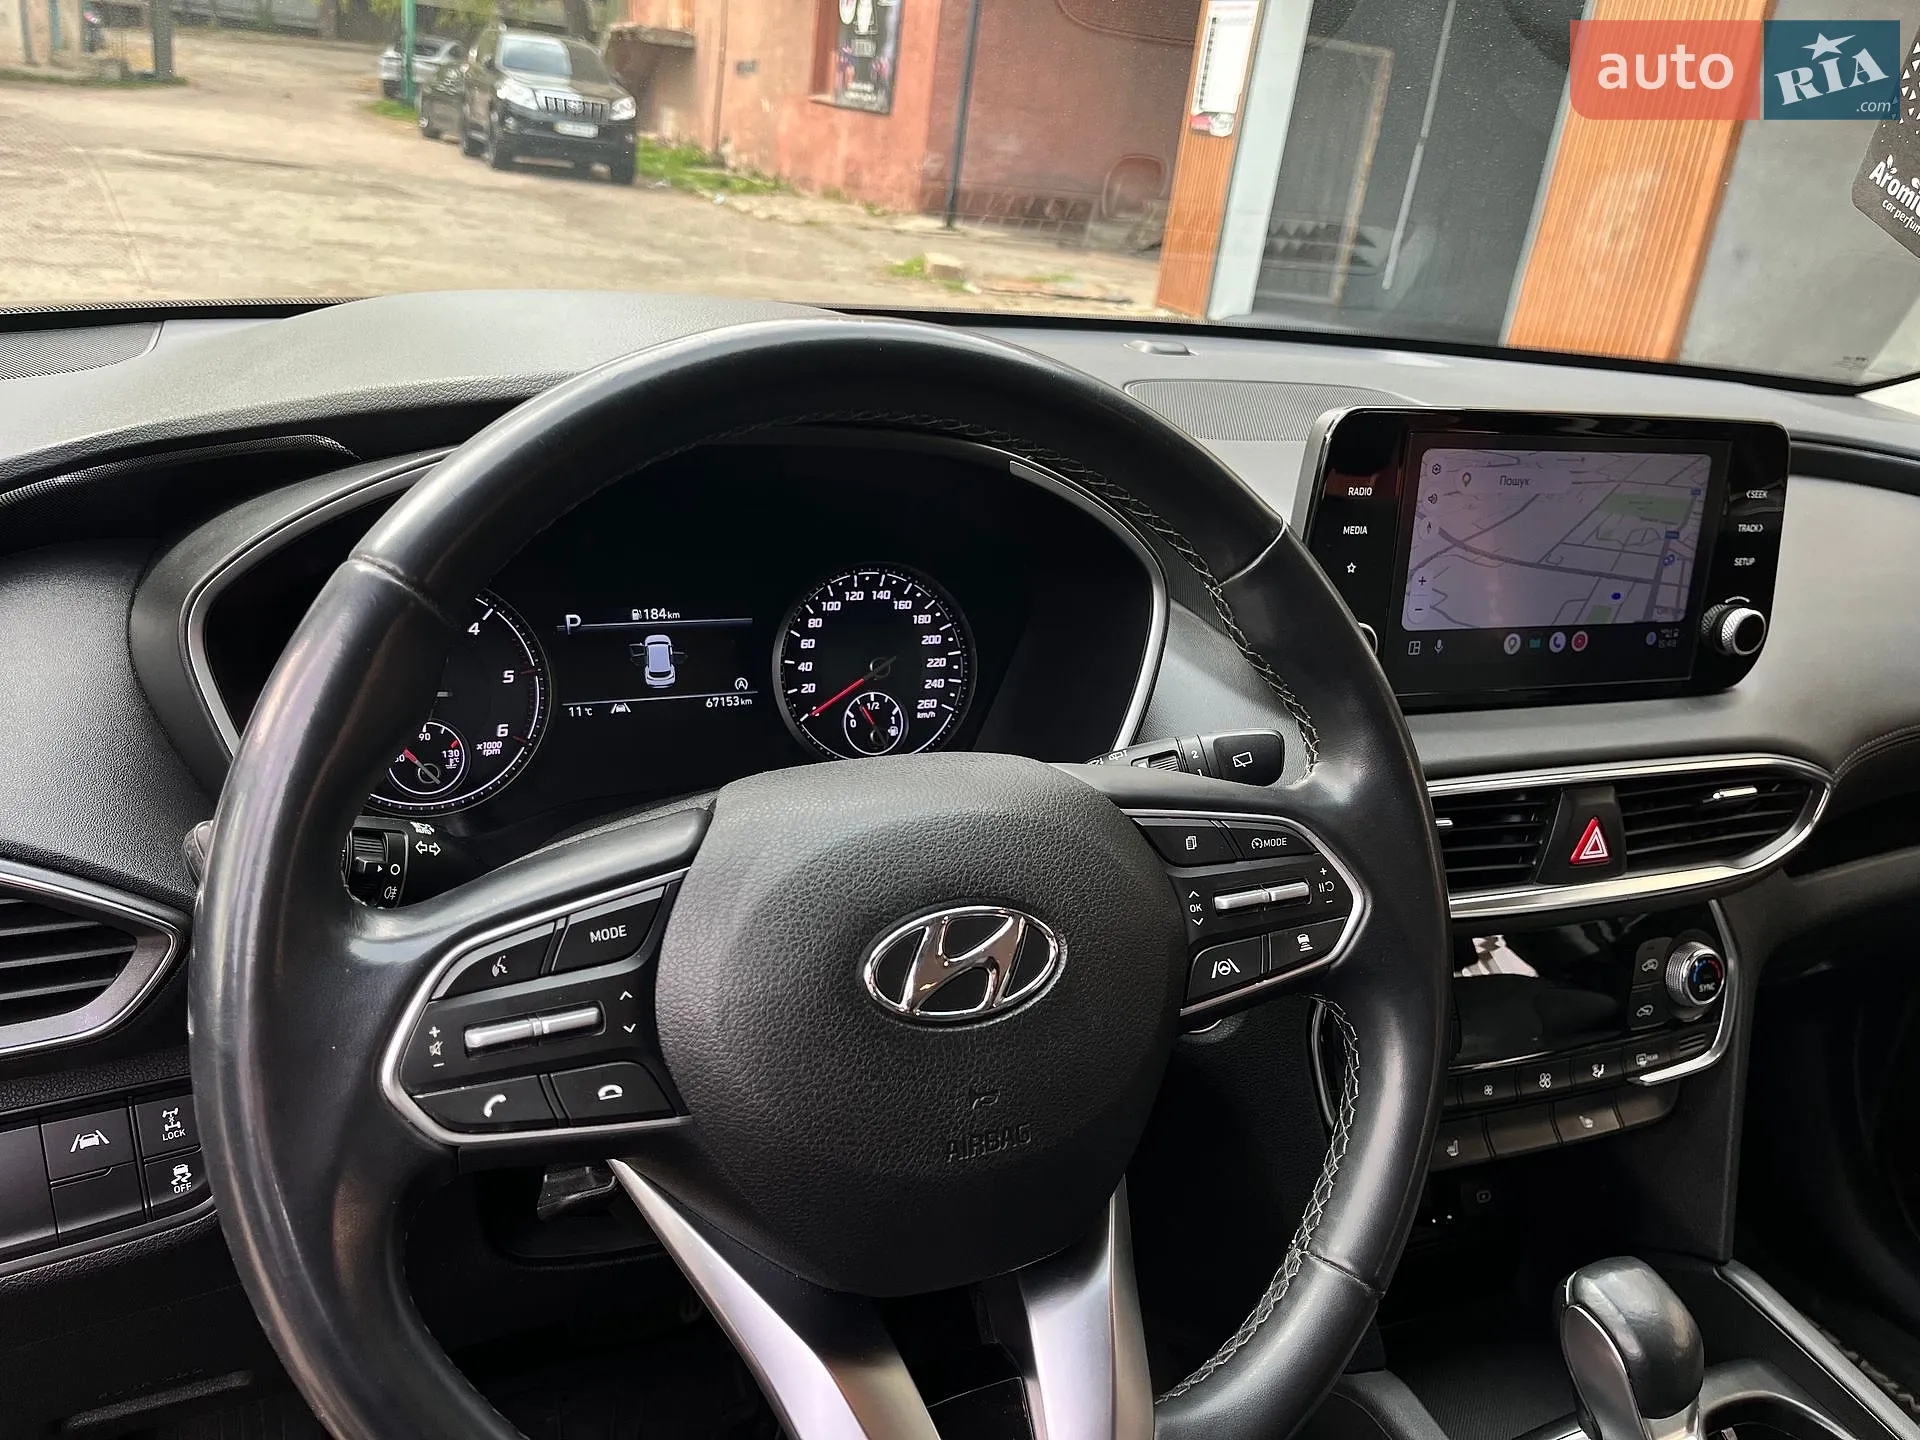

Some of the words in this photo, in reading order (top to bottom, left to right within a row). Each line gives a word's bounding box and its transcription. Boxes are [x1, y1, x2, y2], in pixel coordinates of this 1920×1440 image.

[1868, 160, 1920, 218] Aromi
[1882, 200, 1896, 213] car
[1500, 475, 1530, 488] Пошук
[1347, 486, 1373, 496] RADIO
[1342, 525, 1368, 535] MEDIA
[1734, 557, 1755, 566] SETUP
[844, 591, 864, 601] 120
[872, 590, 891, 600] 140
[821, 601, 841, 611] 100
[893, 600, 912, 610] 160
[565, 614, 582, 635] P
[807, 618, 822, 628] 80
[913, 614, 932, 625] 180
[467, 622, 480, 636] 4
[800, 639, 815, 649] 60
[921, 635, 942, 645] 200
[797, 662, 813, 672] 40
[926, 658, 946, 668] 220
[502, 670, 515, 683] 5
[800, 683, 816, 693] 20
[924, 679, 945, 689] 240
[866, 702, 880, 711] 1/2
[917, 699, 938, 709] 260
[916, 711, 936, 719] km/h
[850, 719, 857, 728] 0
[496, 724, 509, 738] 6
[418, 732, 431, 741] 90
[476, 741, 503, 751] x1000
[442, 749, 460, 758] 130
[482, 748, 501, 756] rpm
[1191, 750, 1199, 758] 2
[1263, 837, 1288, 848] MODE
[1189, 903, 1203, 913] OK
[589, 925, 628, 944] MODE
[1698, 982, 1716, 992] SYNC
[162, 1129, 186, 1141] LOCK
[946, 1124, 1032, 1163] AIRBAG
[173, 1182, 192, 1194] OFF
